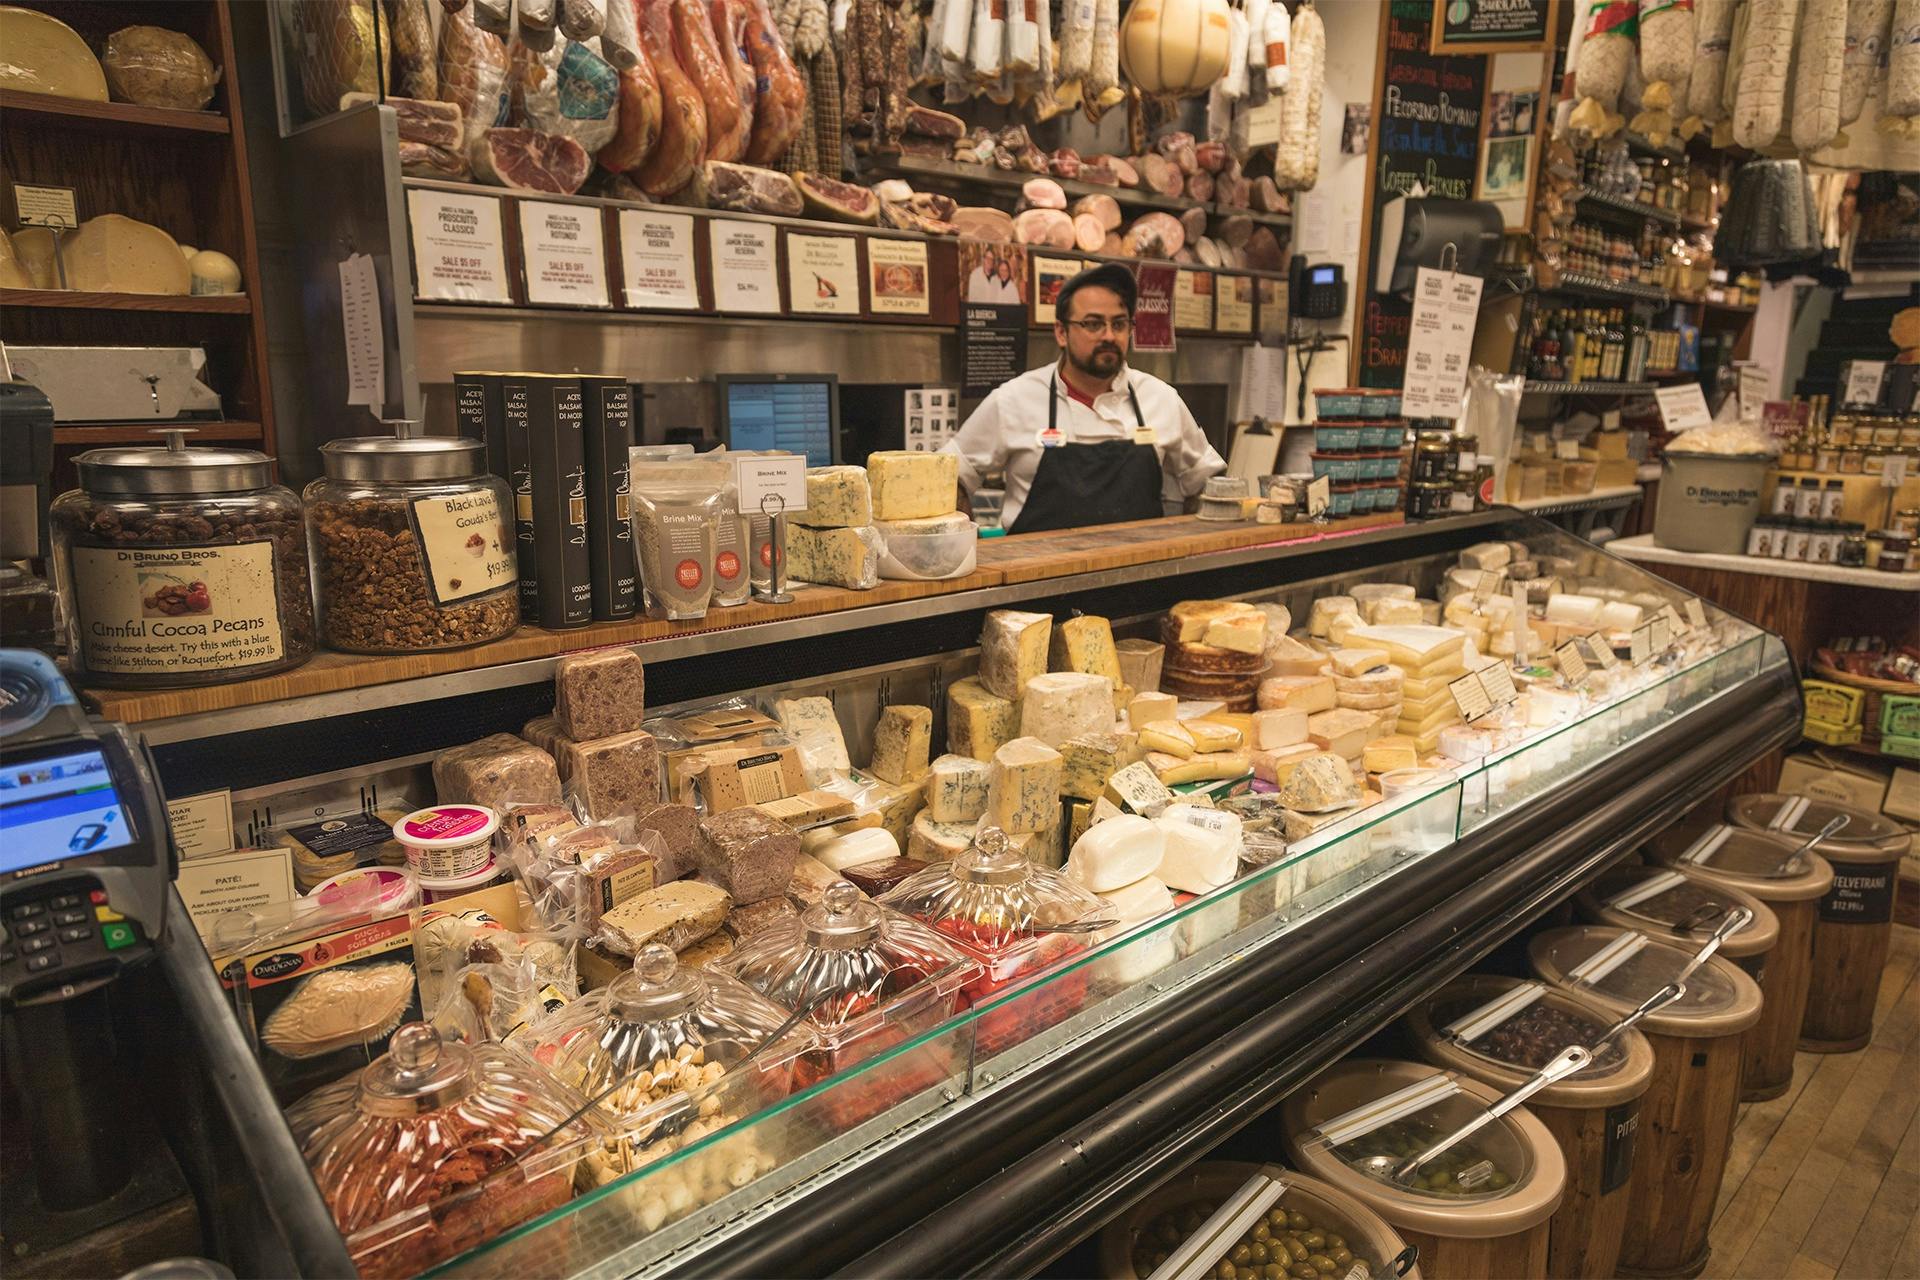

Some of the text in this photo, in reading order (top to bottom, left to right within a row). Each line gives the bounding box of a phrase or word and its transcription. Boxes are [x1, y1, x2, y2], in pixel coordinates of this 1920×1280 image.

[438, 212, 478, 225] PROSCIUTTO
[443, 223, 476, 235] CLASSICO
[545, 220, 580, 232] PROSCIUTTO
[441, 256, 459, 266] SALE
[470, 258, 482, 268] OFF
[548, 262, 564, 271] SALE
[445, 496, 492, 513] Black Lava
[722, 508, 736, 516] Mix
[456, 514, 488, 528] Gouda's
[663, 514, 703, 524] Brine Mix
[92, 617, 265, 638] Cinnful Cocoa Pecans
[180, 642, 198, 655] Try
[200, 640, 219, 650] this
[220, 638, 242, 649] with
[252, 634, 270, 645] blue
[113, 655, 130, 666] like
[132, 657, 164, 667] Stilton
[166, 658, 180, 667] or
[238, 648, 266, 660] $19.99
[266, 644, 276, 656] lb
[170, 807, 191, 817] VIAR
[1834, 876, 1886, 888] TELVETRANO
[193, 908, 220, 916] PICKLES
[354, 928, 379, 940] DUCK
[368, 930, 392, 944] GRAS
